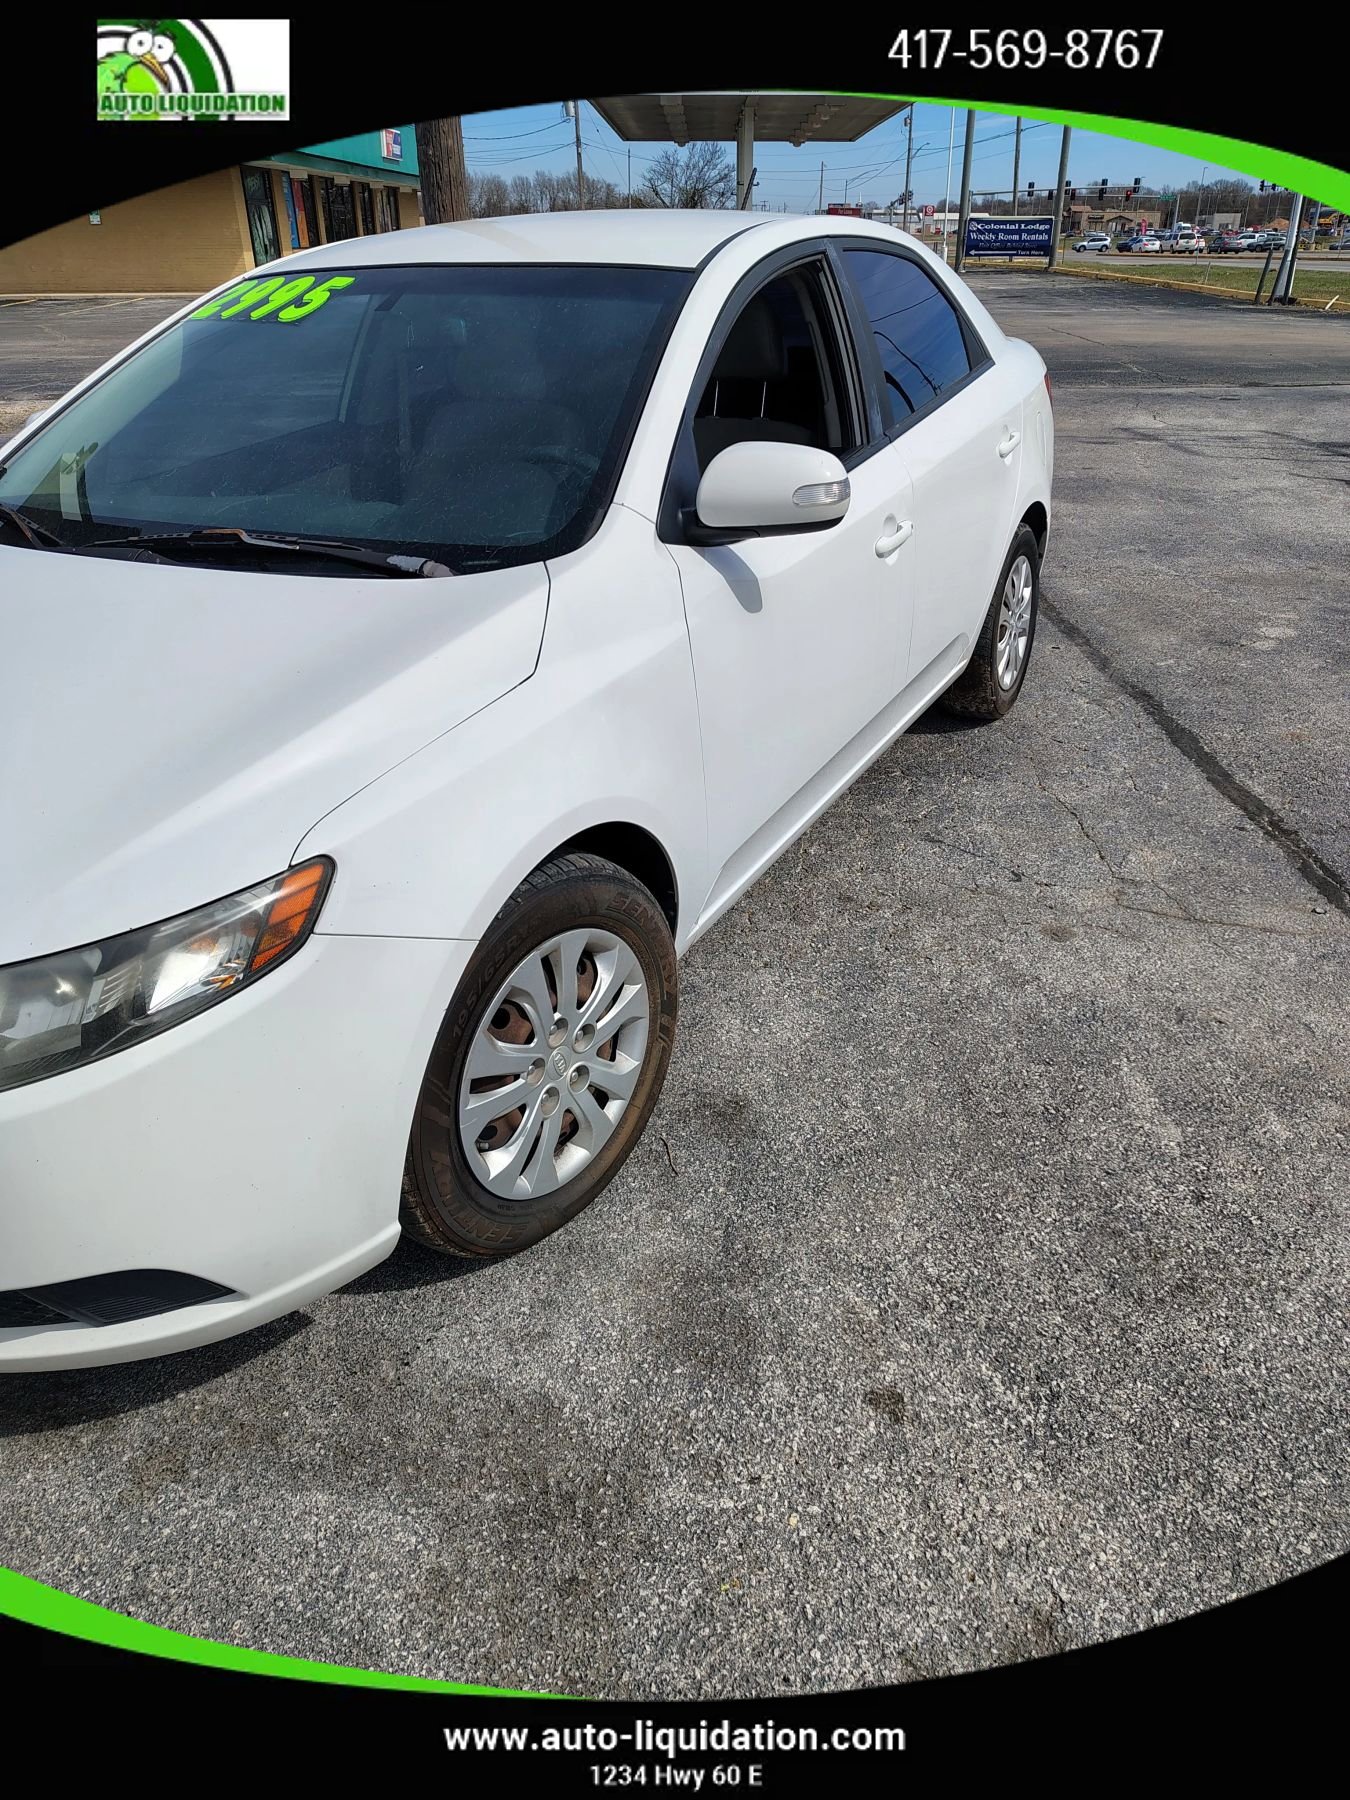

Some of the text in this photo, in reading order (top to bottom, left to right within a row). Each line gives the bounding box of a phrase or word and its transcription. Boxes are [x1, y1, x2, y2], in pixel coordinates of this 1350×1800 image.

[1020, 223, 1050, 231] Lodge
[970, 232, 1049, 242] Weekly Room Rentals
[191, 276, 356, 323] 2995
